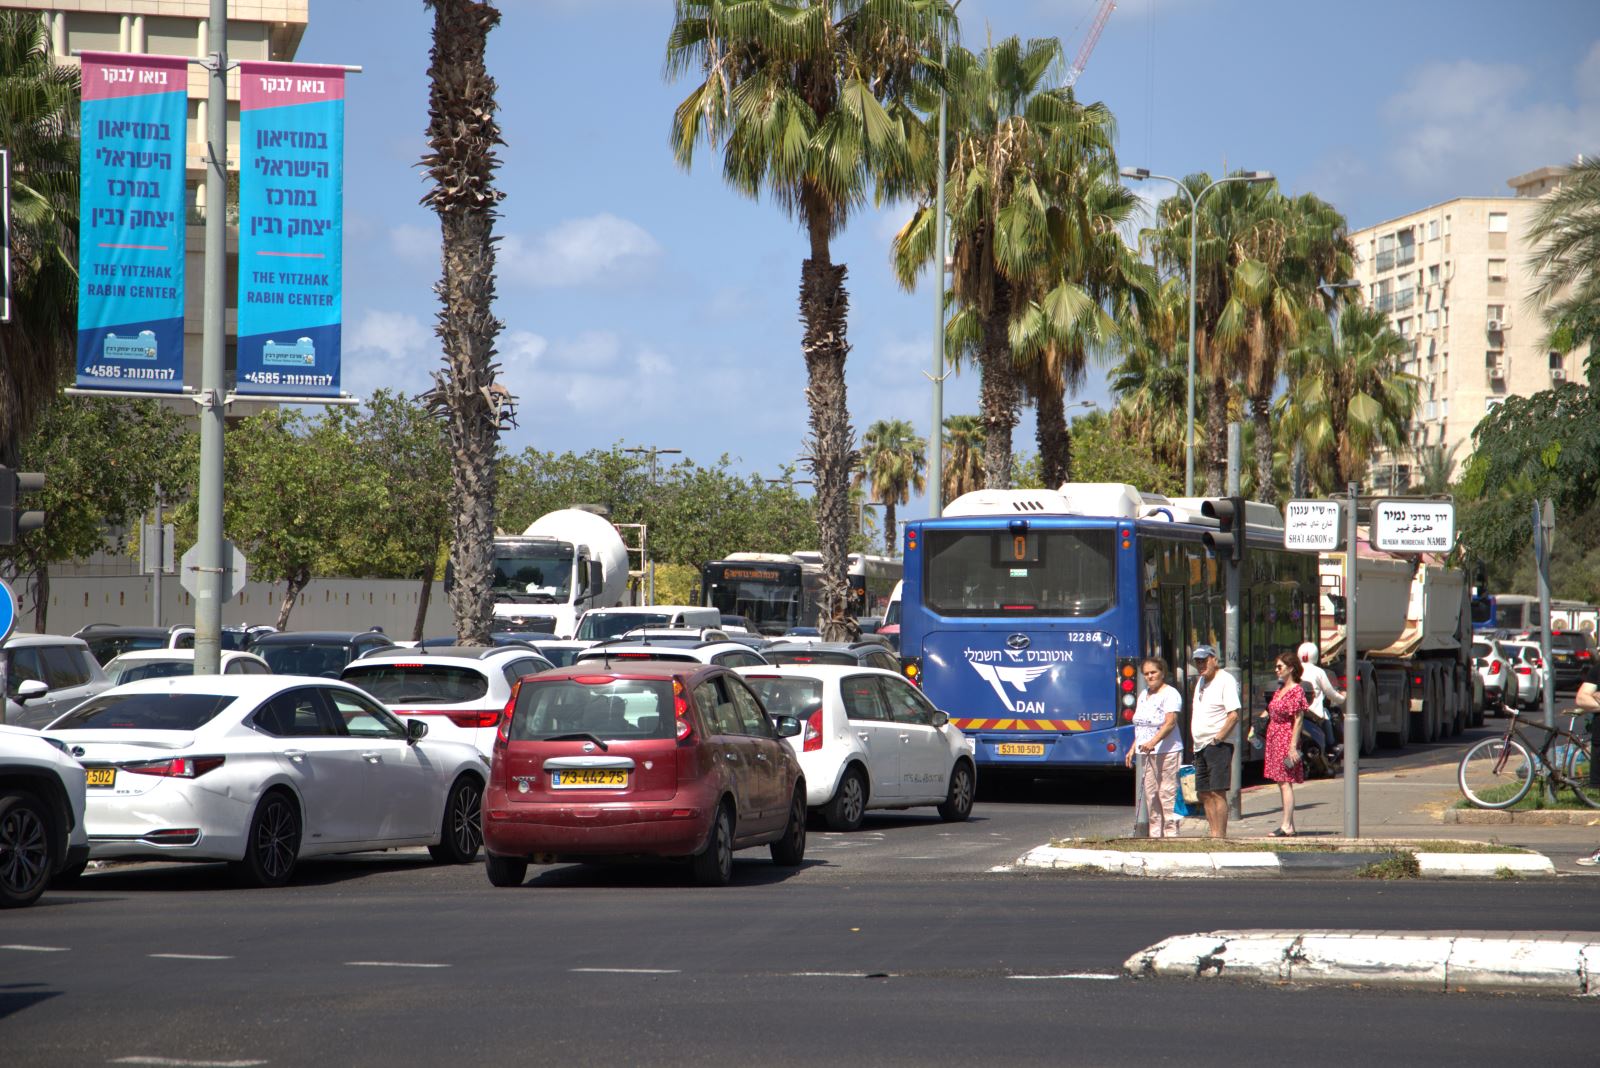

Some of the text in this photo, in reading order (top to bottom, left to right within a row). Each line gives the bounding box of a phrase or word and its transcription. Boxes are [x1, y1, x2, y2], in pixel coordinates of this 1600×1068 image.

[101, 67, 168, 85] בואו לבקר
[260, 76, 326, 94] בואו לבקר
[98, 119, 171, 141] במוזיאון
[256, 129, 328, 149] במוזיאון
[96, 148, 171, 170] הישראלי
[255, 156, 329, 178] הישראלי
[107, 179, 160, 198] במרכז
[266, 187, 317, 206] במרכז
[92, 208, 174, 229] יצחק רבין
[251, 216, 331, 238] יצחק רבין
[94, 263, 172, 278] THE YITZHAK
[253, 271, 329, 286] THE YITZHAK
[88, 283, 177, 299] RABIN CENTER
[247, 291, 334, 306] RABIN CENTER
[123, 367, 175, 380] להזמנות:
[282, 374, 333, 386] להזמנות:
[1290, 506, 1309, 518] עגנון
[1384, 510, 1448, 522] דרך מרדכי נמיר
[1396, 523, 1433, 533] طريق نمير
[1306, 534, 1328, 543] AGNON
[1427, 537, 1447, 546] NAMIR
[964, 647, 1073, 662] אוטובוס חשמלי
[1016, 701, 1045, 714] DAN
[1078, 713, 1114, 721] HIGER
